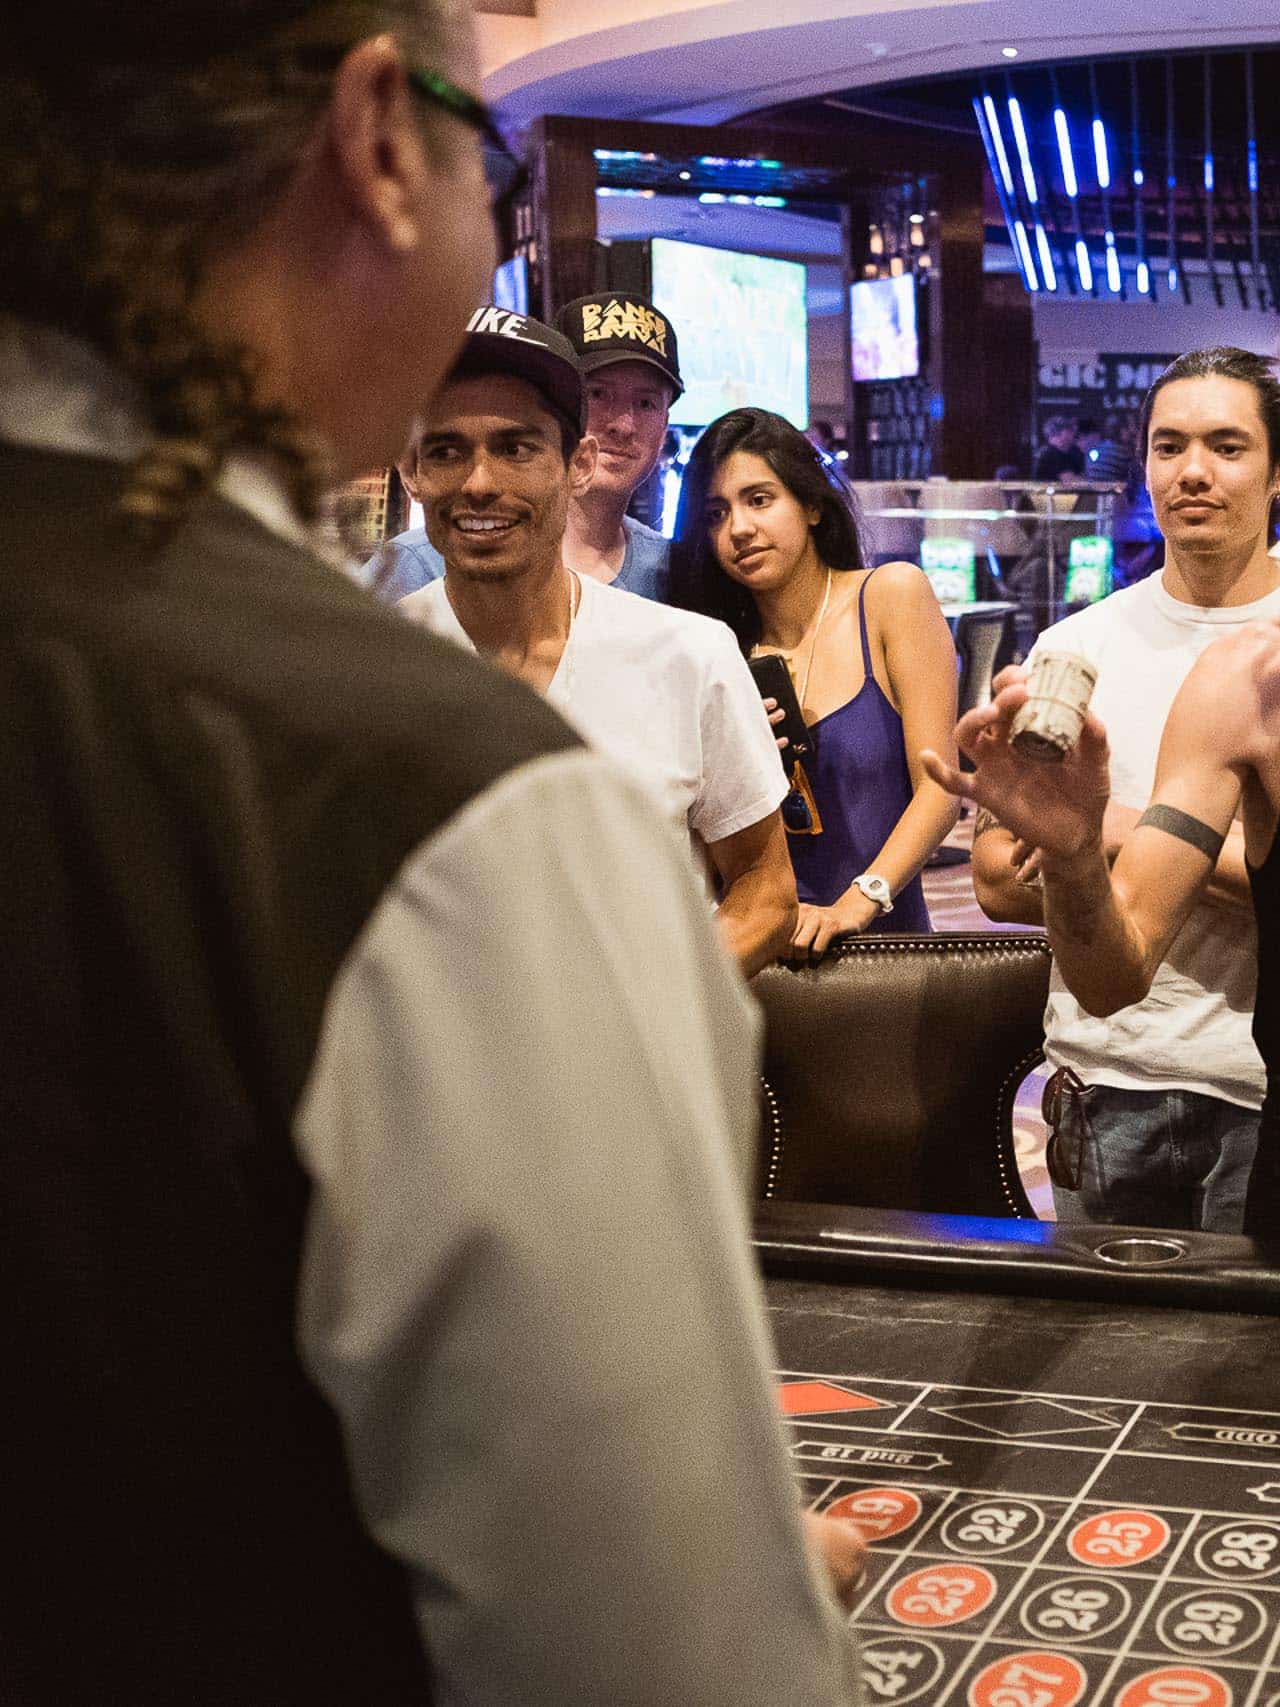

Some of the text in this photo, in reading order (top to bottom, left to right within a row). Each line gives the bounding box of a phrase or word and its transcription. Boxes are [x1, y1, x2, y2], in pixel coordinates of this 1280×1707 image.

[465, 307, 527, 336] IKE
[821, 1447, 914, 1465] 2nd 12
[1215, 1430, 1277, 1444] ODD
[851, 1497, 904, 1531] 19
[958, 1508, 1027, 1545] 22
[1086, 1519, 1151, 1557] 25
[1212, 1531, 1278, 1570] 28
[902, 1575, 976, 1616] 23
[1037, 1588, 1110, 1632] 26
[1174, 1601, 1244, 1646] 29
[860, 1651, 923, 1696] 24
[988, 1662, 1063, 1707] 27
[1141, 1679, 1211, 1707] 0
